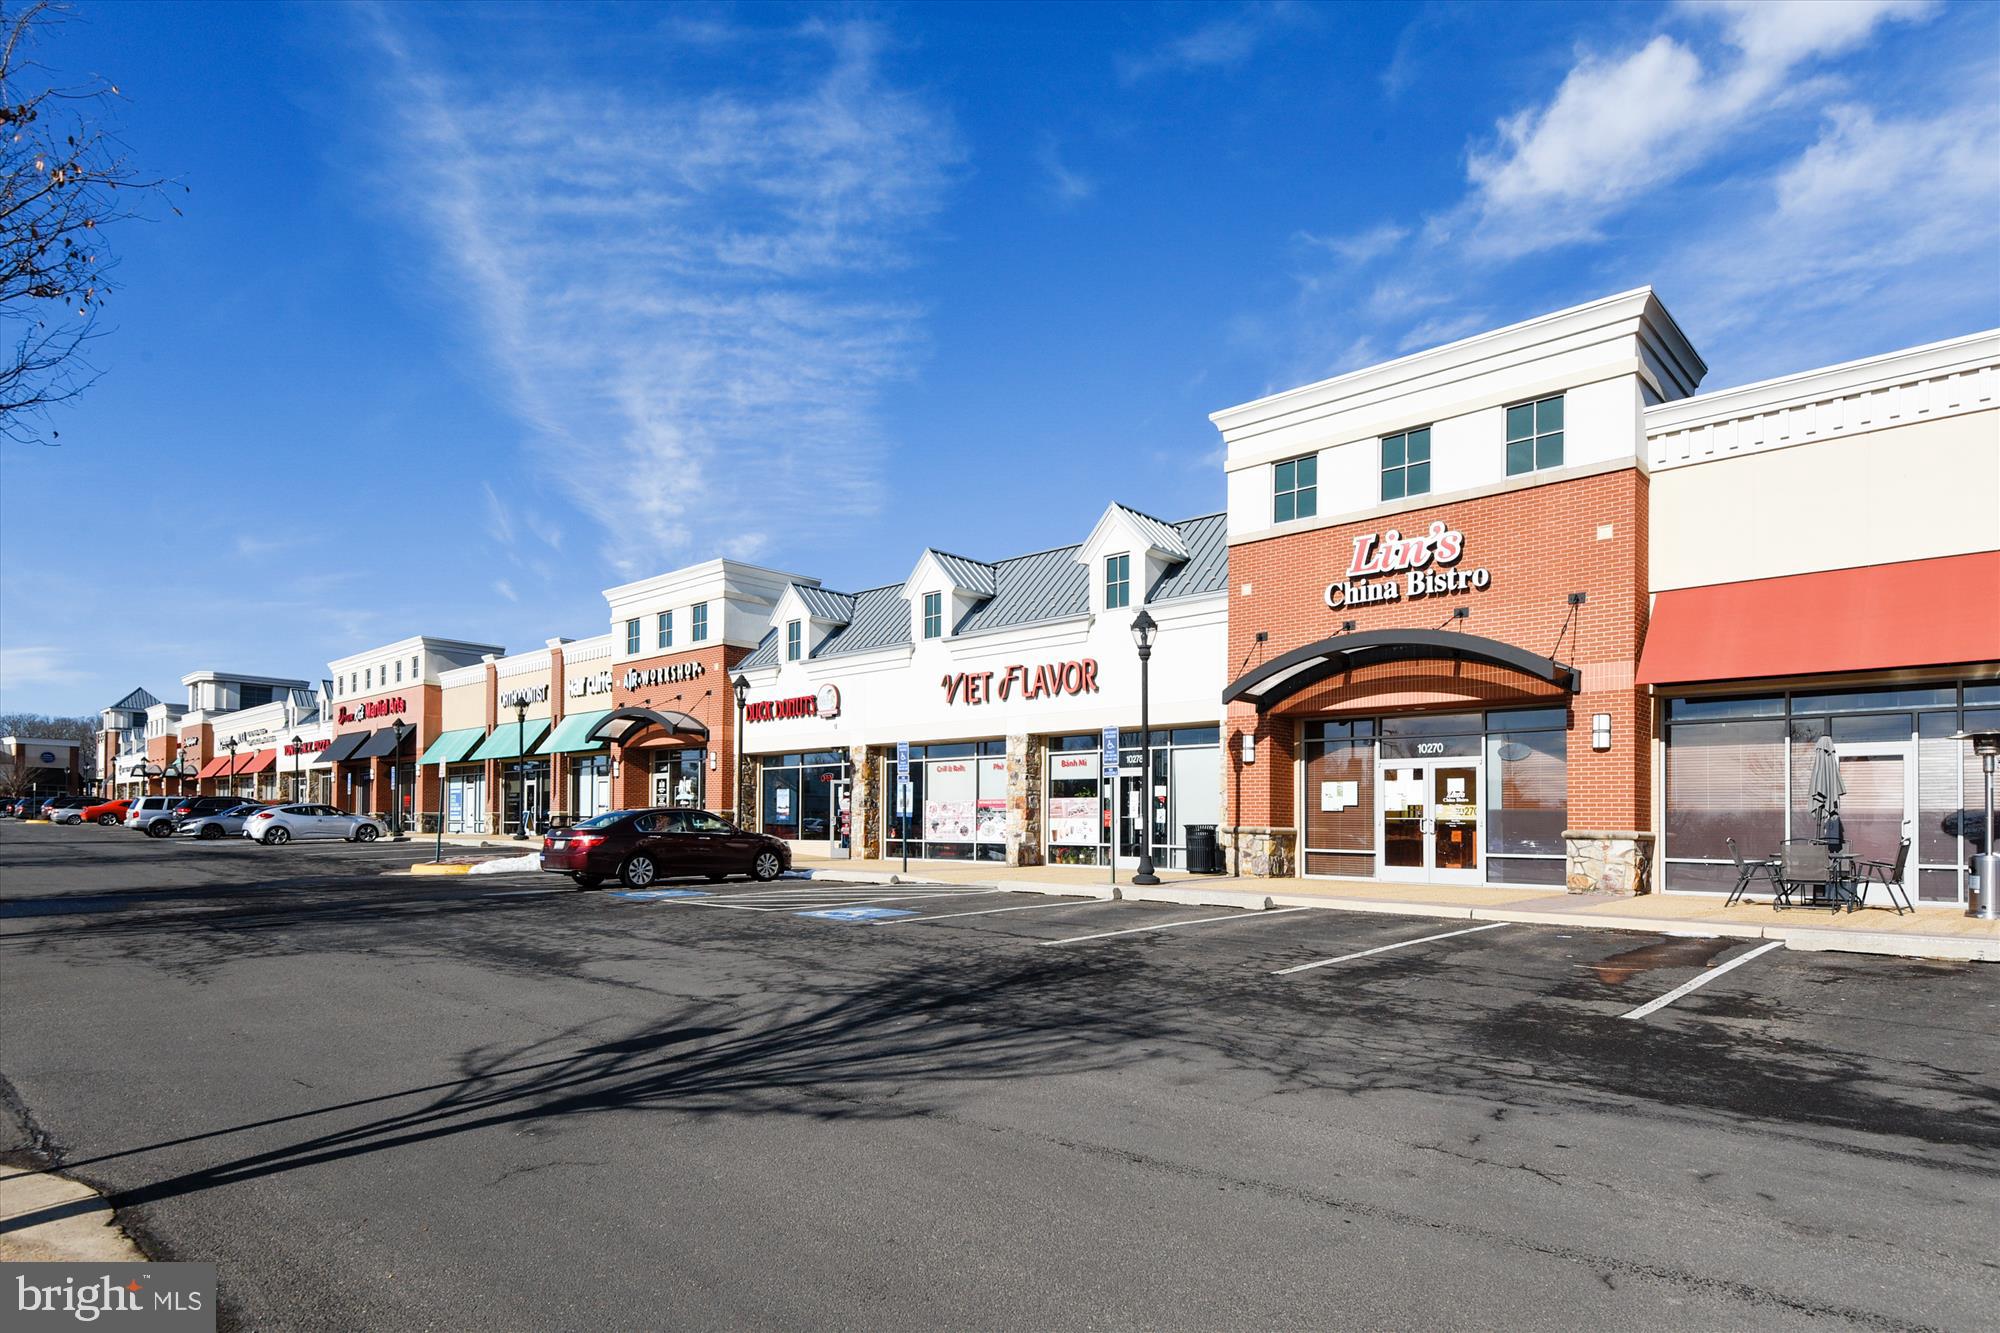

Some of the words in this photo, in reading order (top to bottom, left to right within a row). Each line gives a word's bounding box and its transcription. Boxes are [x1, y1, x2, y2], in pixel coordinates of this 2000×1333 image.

[1346, 521, 1463, 577] Lin's
[1324, 579, 1398, 608] China
[1406, 567, 1489, 597] Bistro
[941, 671, 993, 705] VIET
[998, 658, 1099, 702] FLAVOR
[746, 700, 773, 722] DUCK
[775, 695, 816, 719] DONUTS
[1417, 743, 1444, 754] 10270
